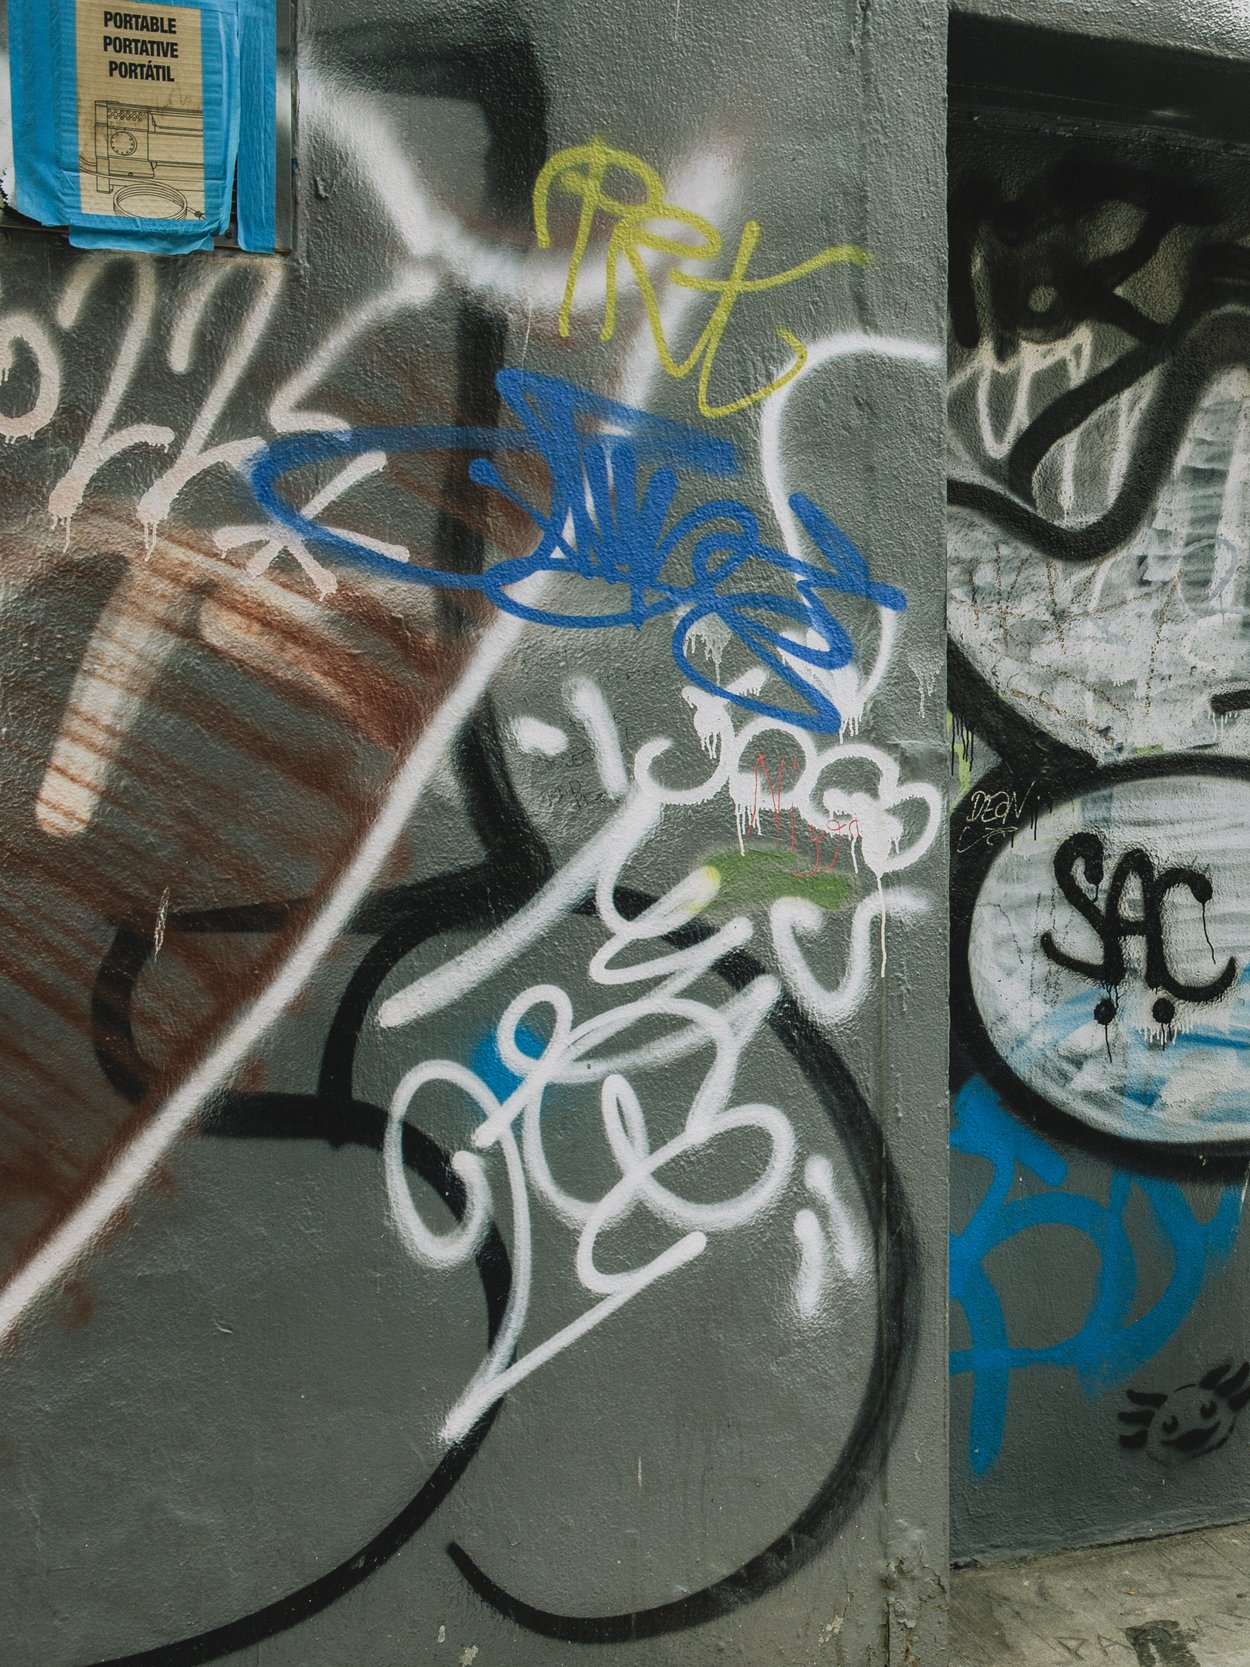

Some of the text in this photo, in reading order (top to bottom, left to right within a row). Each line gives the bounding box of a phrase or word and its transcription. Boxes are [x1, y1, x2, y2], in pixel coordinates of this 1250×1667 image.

[103, 10, 177, 35] PORTABLE
[103, 36, 179, 59] PORTATIVE
[109, 60, 175, 82] PORTÁTIL
